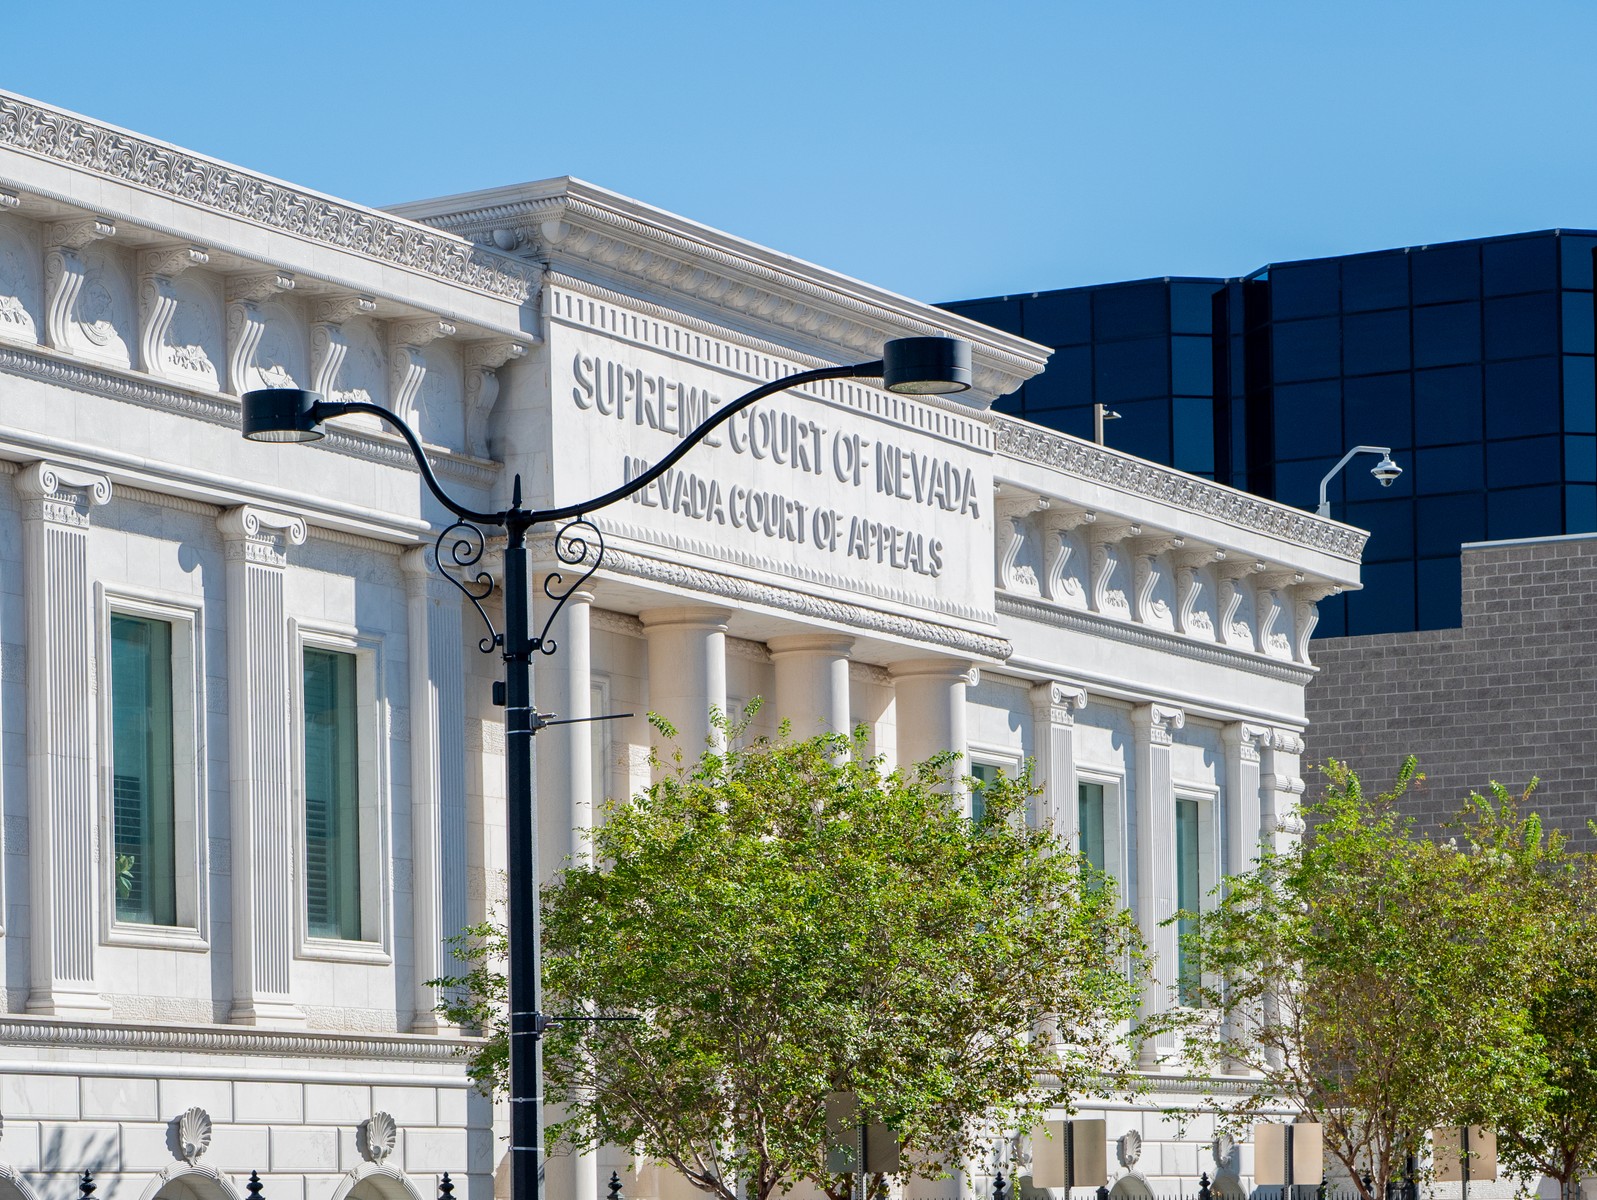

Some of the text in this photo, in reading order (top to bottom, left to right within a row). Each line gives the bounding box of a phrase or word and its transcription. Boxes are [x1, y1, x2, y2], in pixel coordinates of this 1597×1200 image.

[573, 350, 980, 520] SUPREME COURT OF NEVADA
[624, 455, 944, 578] NEVADA COURT OF APPEALS
